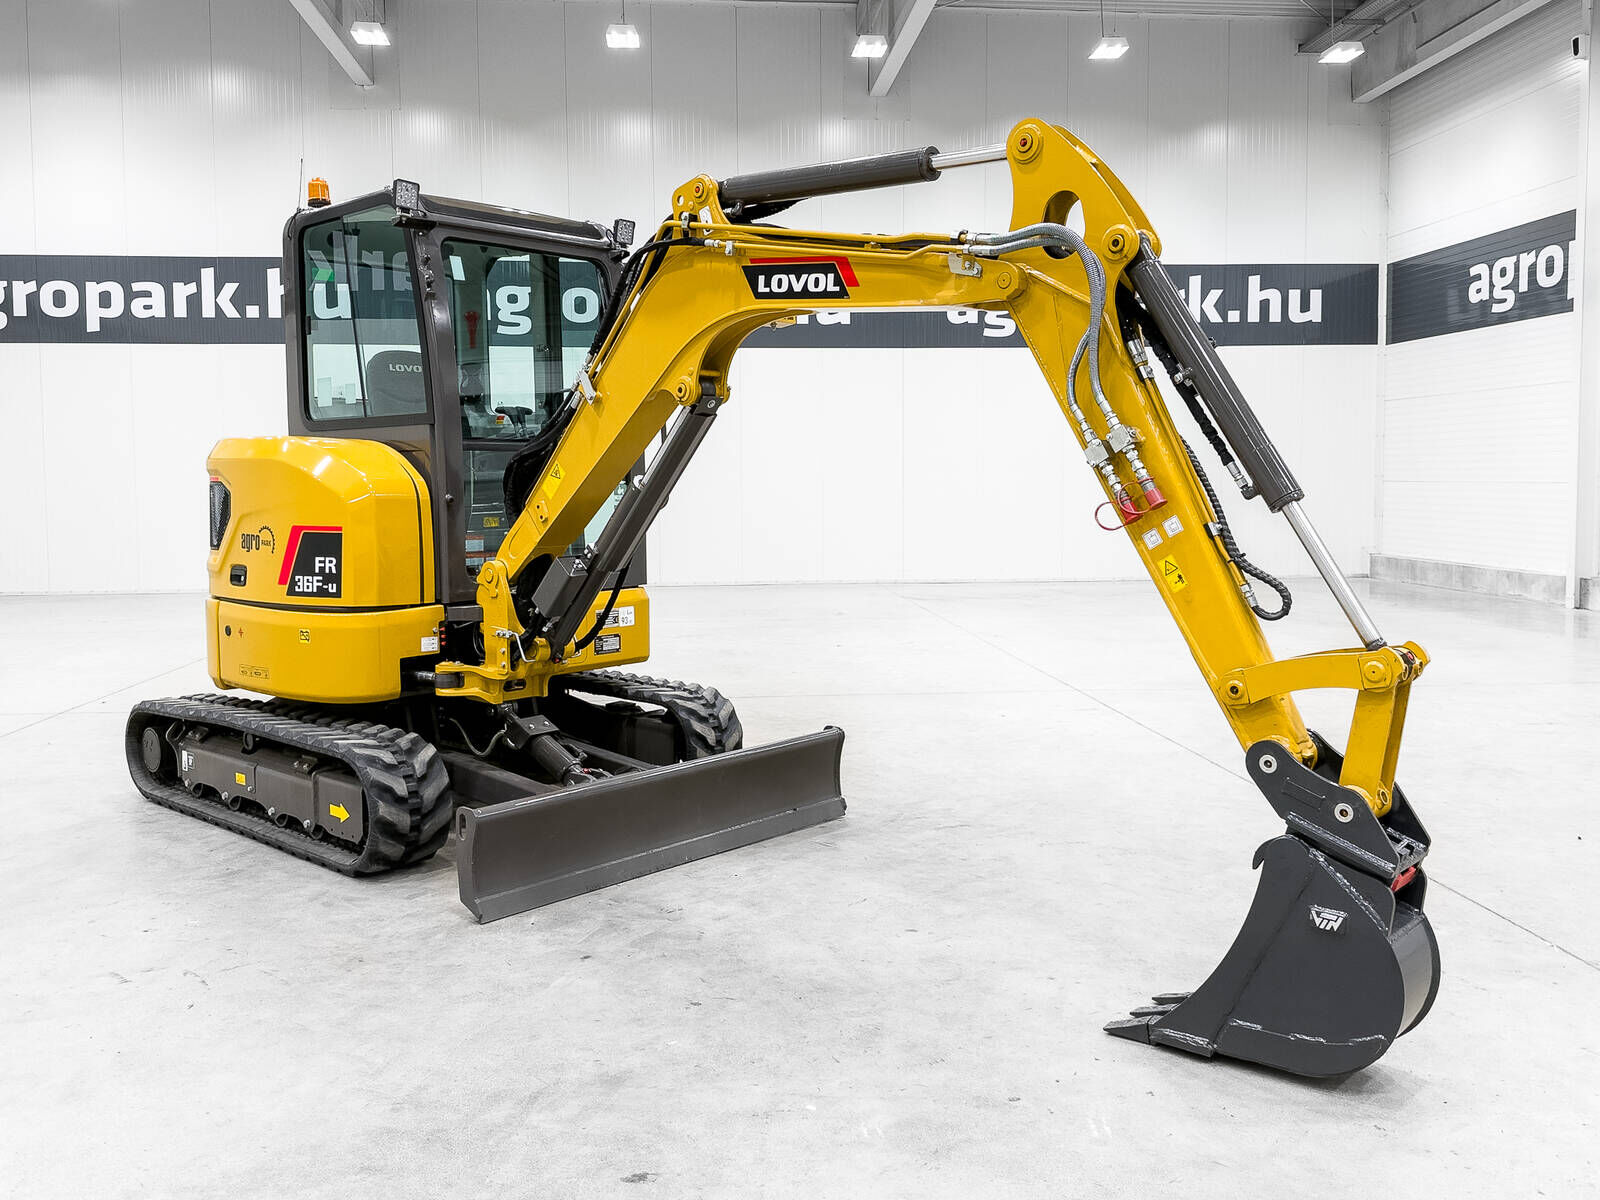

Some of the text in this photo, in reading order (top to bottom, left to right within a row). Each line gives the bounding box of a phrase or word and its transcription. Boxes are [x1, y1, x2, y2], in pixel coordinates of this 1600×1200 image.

[758, 273, 840, 293] LOVOL
[389, 363, 423, 373] LOVO
[241, 533, 260, 552] agro
[314, 556, 337, 574] FR
[294, 575, 337, 593] 36F-u
